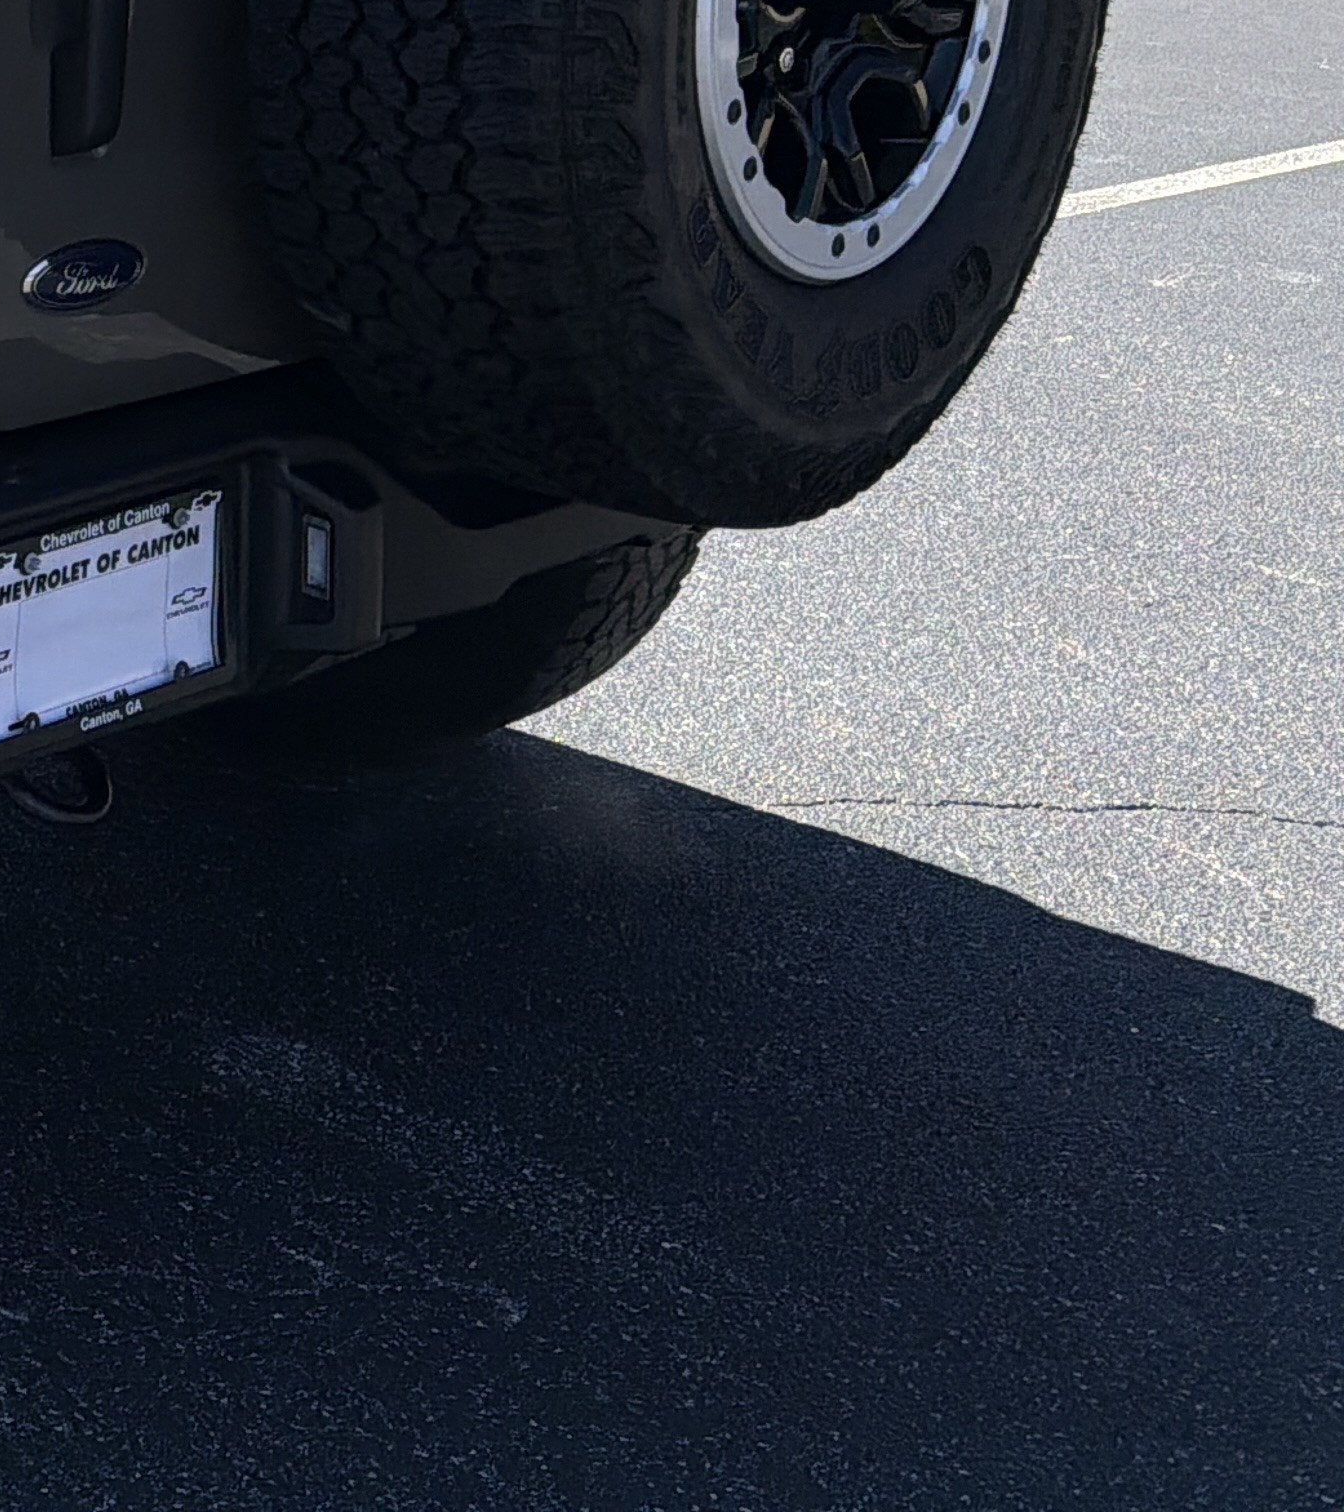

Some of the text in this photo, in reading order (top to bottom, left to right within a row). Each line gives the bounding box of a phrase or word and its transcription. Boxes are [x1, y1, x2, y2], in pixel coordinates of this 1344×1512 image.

[55, 261, 123, 296] Ford
[40, 502, 170, 552] Chevrolet of Canton
[96, 549, 121, 573] OF
[127, 525, 200, 564] CANTON
[80, 698, 143, 731] Canton, GA
